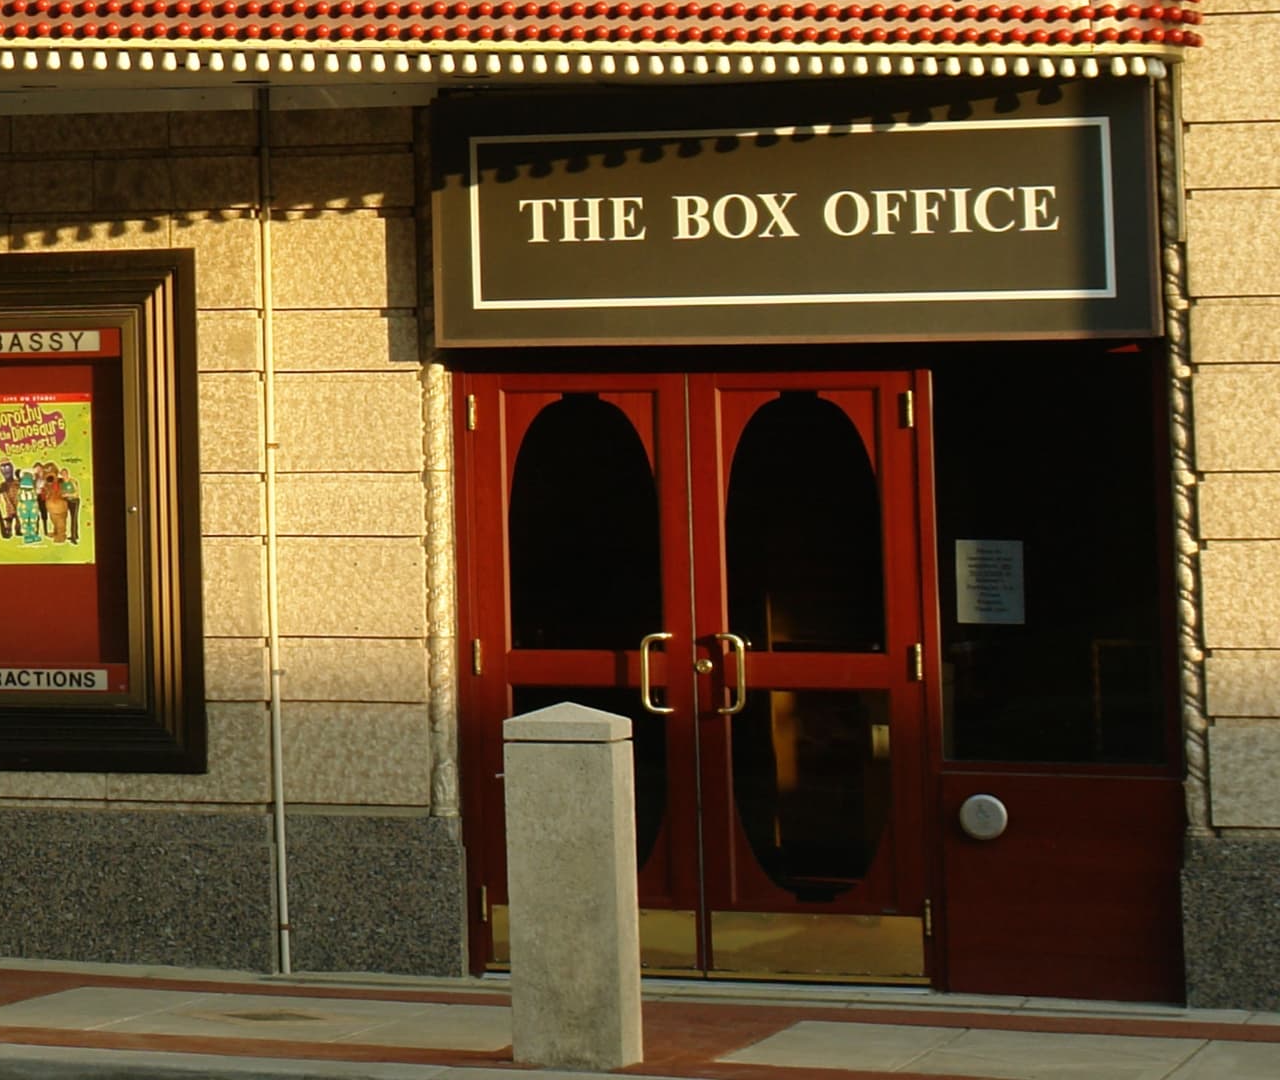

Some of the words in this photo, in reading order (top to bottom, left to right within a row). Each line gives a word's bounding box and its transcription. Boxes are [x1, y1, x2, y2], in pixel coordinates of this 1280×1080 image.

[519, 197, 646, 243] THE
[673, 192, 799, 240] BOX
[823, 185, 1060, 236] OFFICE
